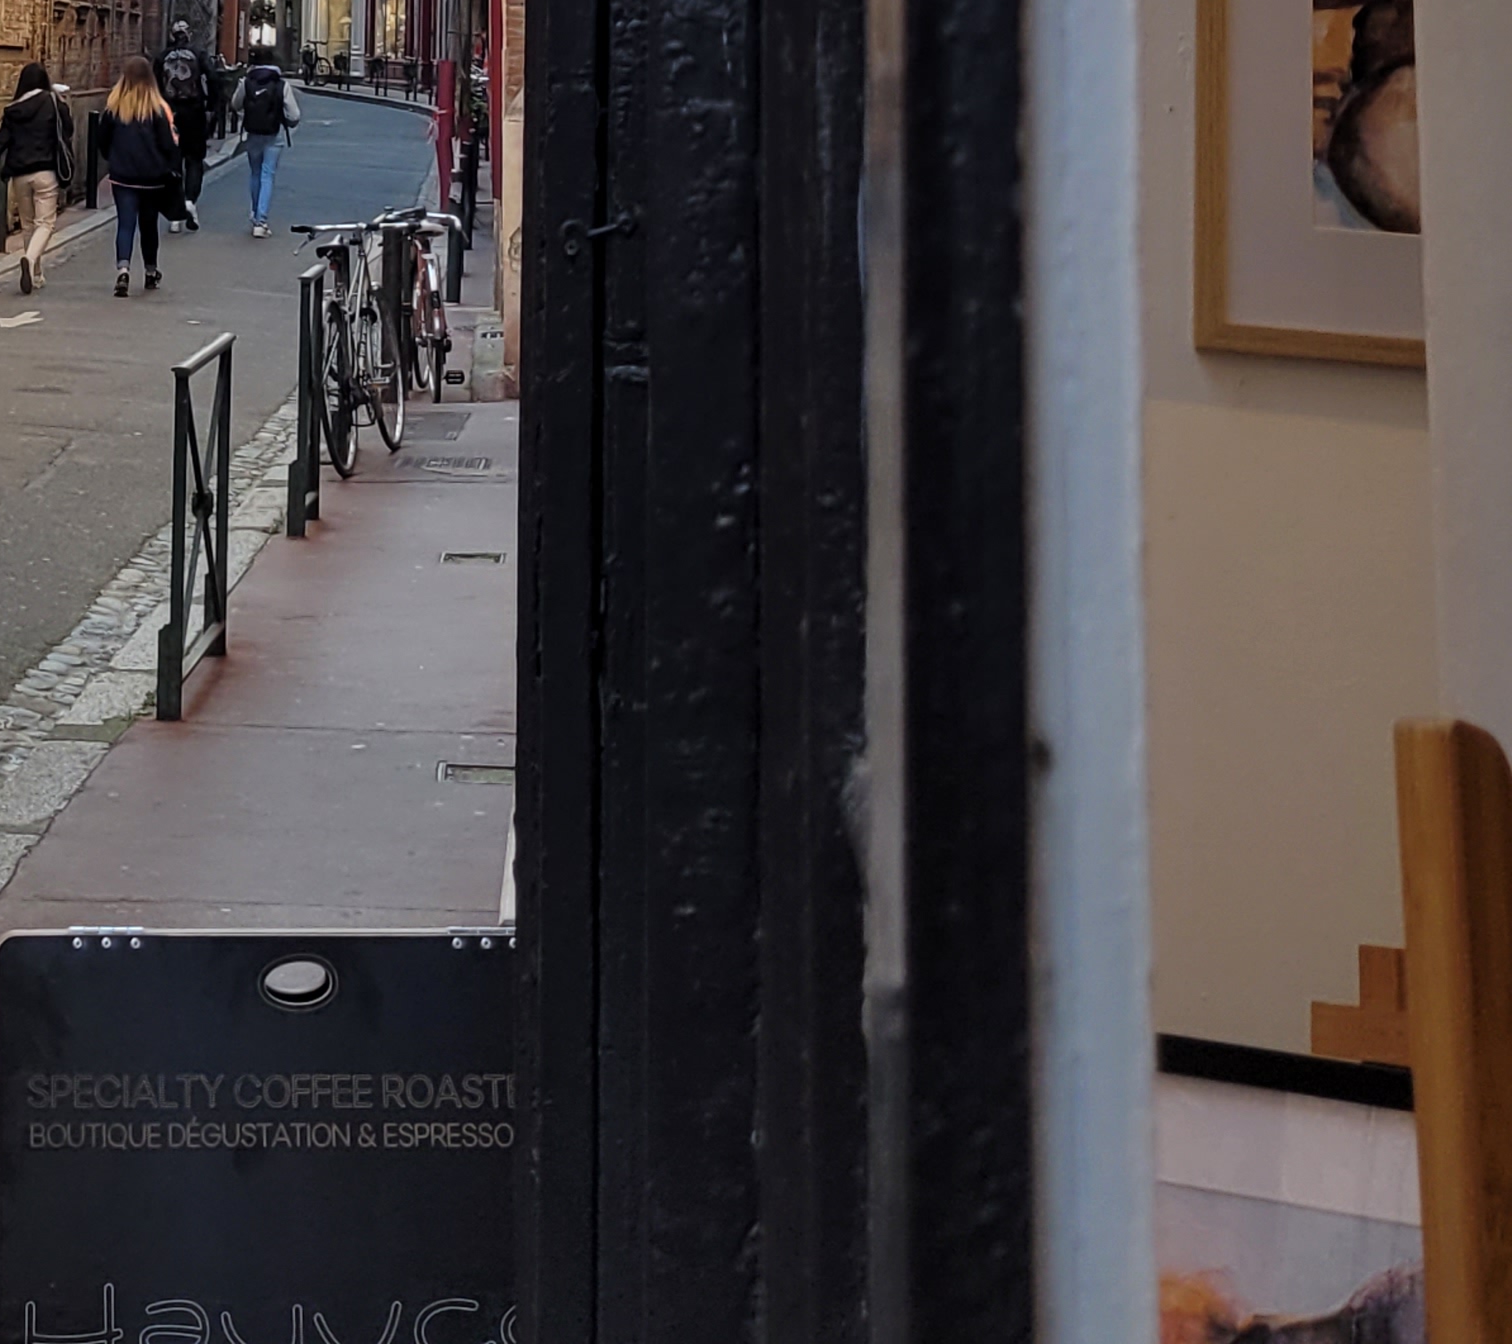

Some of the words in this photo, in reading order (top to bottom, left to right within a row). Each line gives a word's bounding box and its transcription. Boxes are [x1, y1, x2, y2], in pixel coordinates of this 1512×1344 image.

[27, 1073, 225, 1109] SPECIALTY
[233, 1073, 374, 1109] COFFEE
[29, 1122, 162, 1150] BOUTIQUE
[167, 1115, 351, 1149] DÉGUSTATION
[357, 1122, 378, 1148] &
[382, 1122, 515, 1148] ESPRESSO
